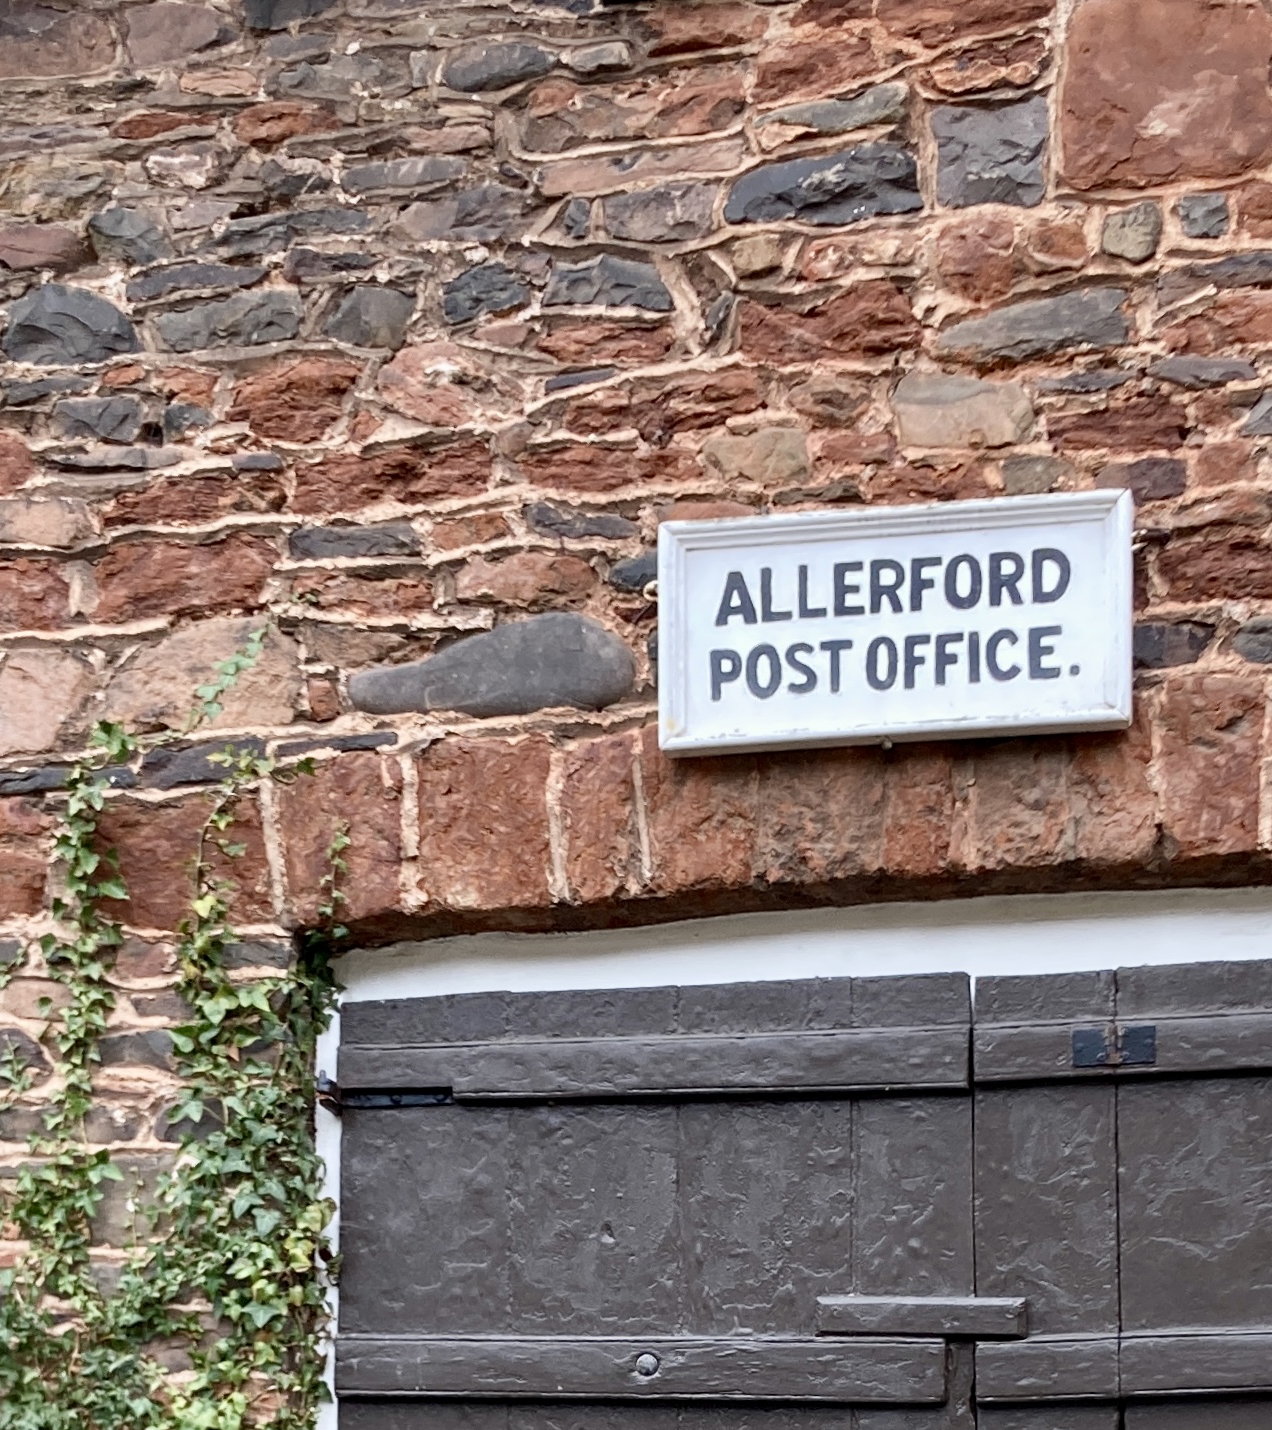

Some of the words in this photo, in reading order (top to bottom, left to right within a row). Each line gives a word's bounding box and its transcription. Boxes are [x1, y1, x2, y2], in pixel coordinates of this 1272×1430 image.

[714, 547, 1072, 627] ALLERFORD
[709, 639, 853, 702] POST
[865, 625, 1081, 692] OFFICE.
